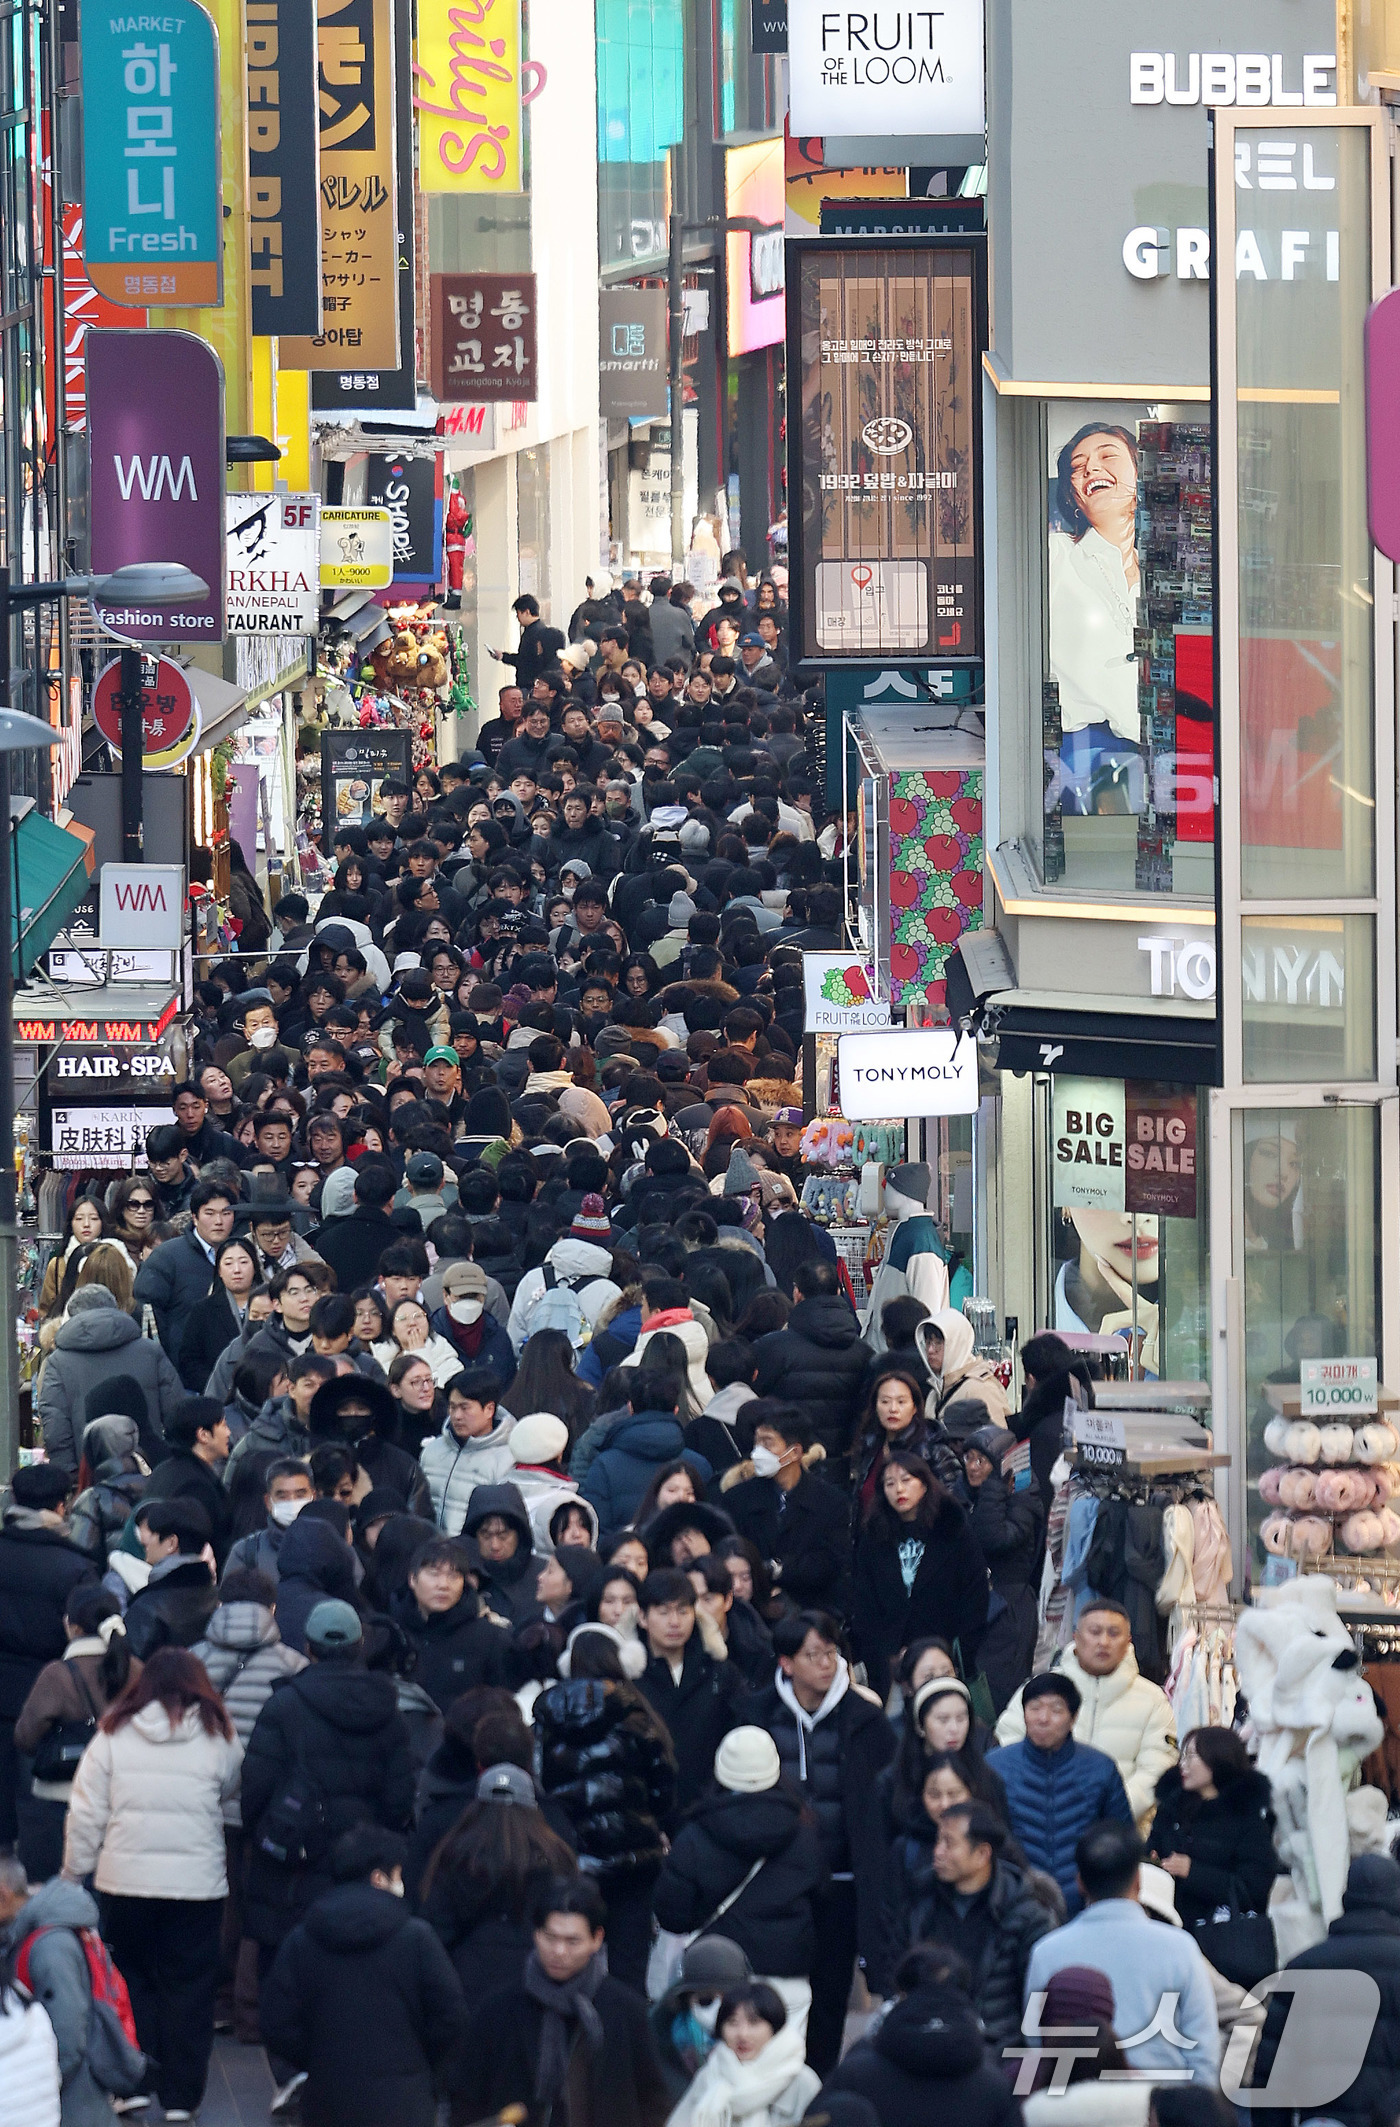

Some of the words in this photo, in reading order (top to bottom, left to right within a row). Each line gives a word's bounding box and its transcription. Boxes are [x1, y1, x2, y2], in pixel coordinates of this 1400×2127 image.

[110, 16, 186, 34] MARKET
[822, 12, 945, 51] FRUIT
[821, 72, 847, 85] THE
[854, 56, 945, 84] LOOM
[824, 58, 845, 70] OF
[1130, 52, 1337, 106] BUBBLE
[122, 42, 178, 220] 하모니
[109, 225, 198, 252] Fresh
[124, 275, 176, 294] 명동점
[448, 290, 531, 330] 명동
[448, 335, 531, 375] 교자
[599, 358, 659, 372] smartti
[340, 375, 380, 391] 명동점
[114, 455, 199, 501] WM
[284, 505, 312, 527] 5F
[322, 512, 381, 521] CARICATURE
[228, 570, 311, 592] RKHA
[99, 608, 163, 627] fashion
[170, 614, 215, 628] store
[115, 884, 167, 912] WM
[816, 1012, 850, 1025] FRUIT
[18, 1021, 55, 1041] WM
[61, 1021, 98, 1041] WM
[105, 1022, 141, 1041] WM
[853, 1065, 964, 1082] TONYMOLY
[101, 1112, 143, 1122] KARIN
[1066, 1110, 1114, 1137] BIG
[60, 1126, 126, 1151] 皮肤科
[1137, 1115, 1187, 1145] BIG
[1057, 1137, 1123, 1167] SALE
[1128, 1143, 1195, 1174] SALE
[1072, 1186, 1108, 1196] TONYMOLY
[1143, 1193, 1179, 1203] TONYMOLY
